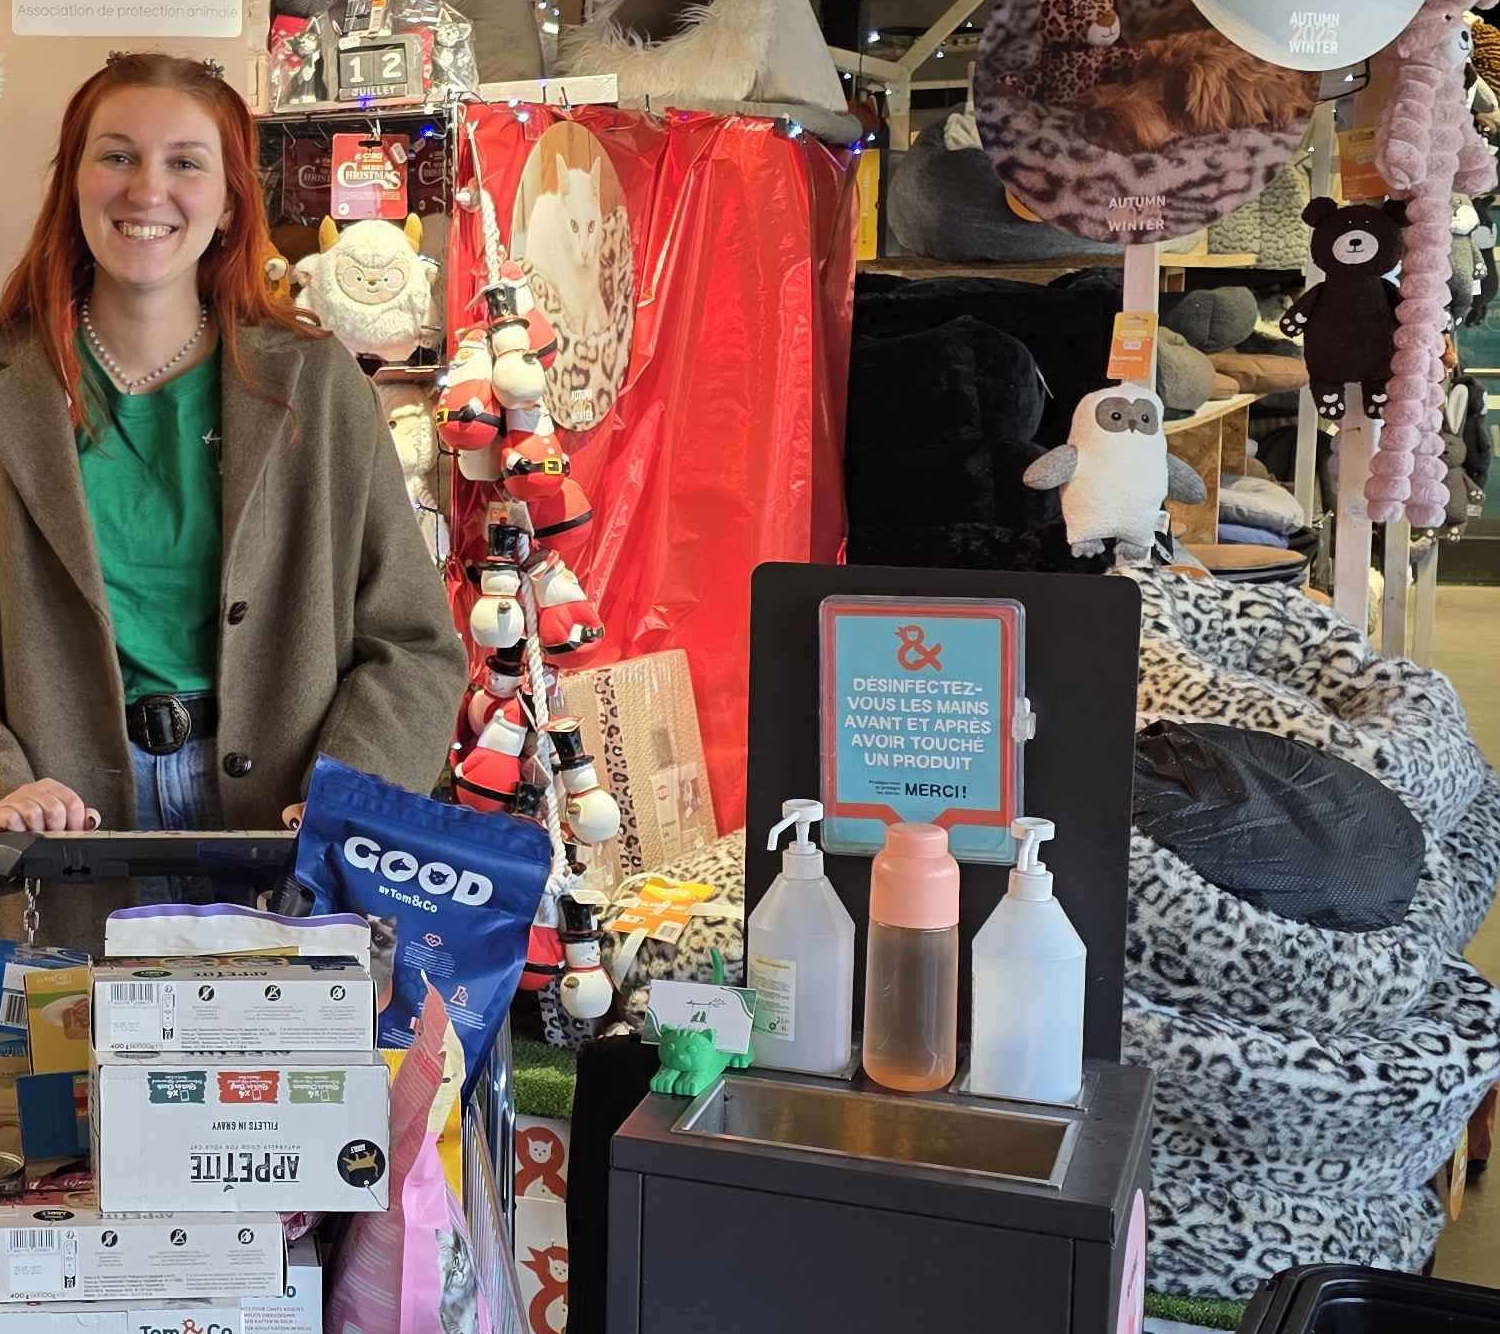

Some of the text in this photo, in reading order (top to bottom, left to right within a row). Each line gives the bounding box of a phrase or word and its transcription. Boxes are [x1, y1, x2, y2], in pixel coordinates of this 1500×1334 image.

[18, 4, 94, 18] Association
[97, 4, 114, 18] de
[117, 4, 187, 19] protection
[1289, 11, 1340, 27] AUTUMN
[1289, 41, 1339, 55] WINTER
[351, 85, 398, 97] JUILLET
[336, 161, 402, 190] CHRISTMAS
[1108, 194, 1167, 209] AUTUMN
[1109, 219, 1165, 232] WINTER
[893, 623, 942, 673] &
[852, 675, 983, 696] DÉSINFECTEZ-
[847, 696, 990, 716] VOUS LES MAINS
[844, 714, 902, 730] AVANT
[907, 717, 932, 732] ET
[851, 733, 986, 754] AVOIR TOUCHÉ
[864, 752, 973, 771] UN PRODUIT
[343, 835, 494, 907] GOOD
[379, 885, 439, 914] BY Tom&Co
[211, 1120, 279, 1131] FILLETS IN GRAVY
[190, 1152, 301, 1183] APPETITE
